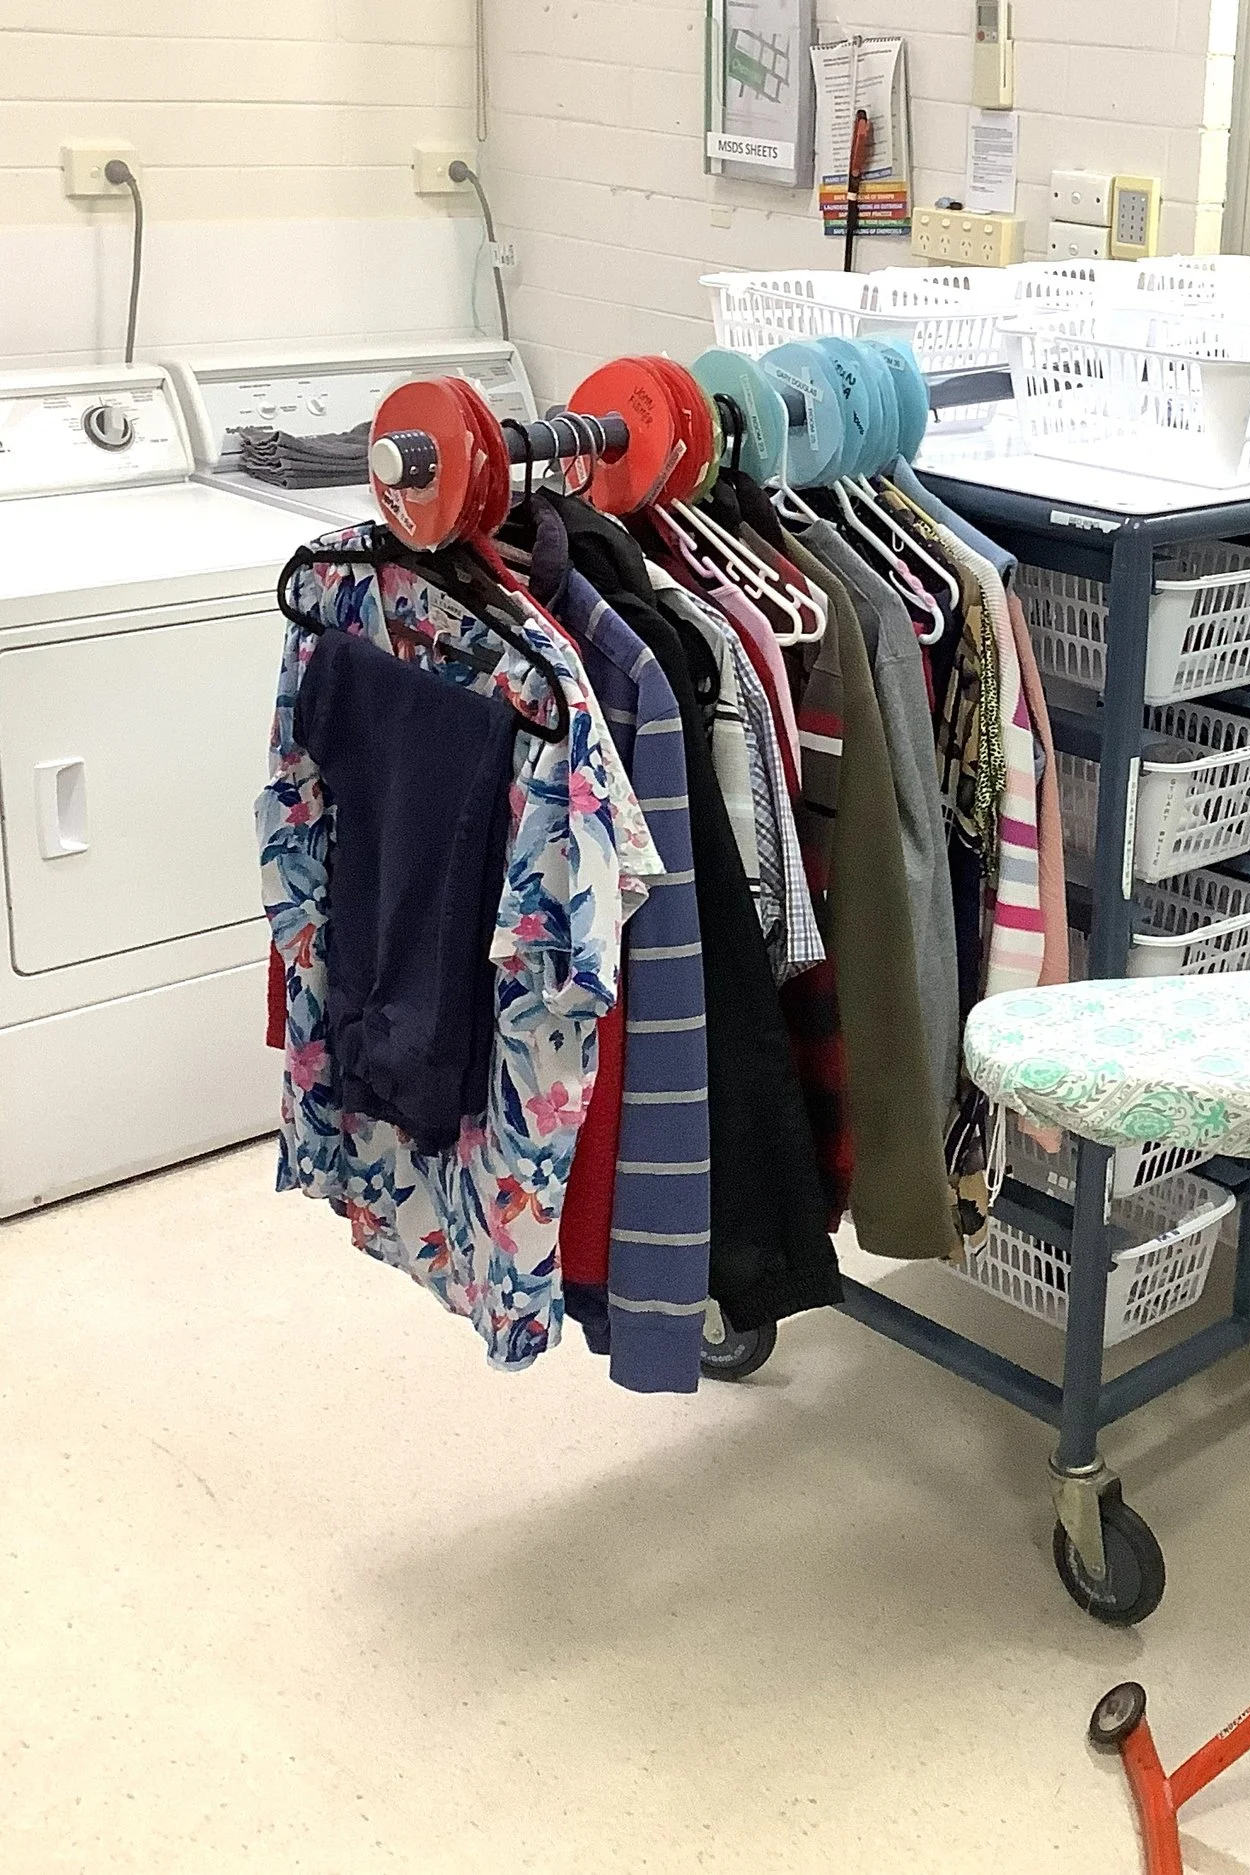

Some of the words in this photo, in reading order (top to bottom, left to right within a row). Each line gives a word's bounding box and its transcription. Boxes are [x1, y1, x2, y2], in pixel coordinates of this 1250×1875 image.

[718, 140, 743, 155] MSDS
[745, 143, 778, 159] SHEETS
[752, 416, 762, 440] ROOM
[1163, 778, 1176, 822] STUART
